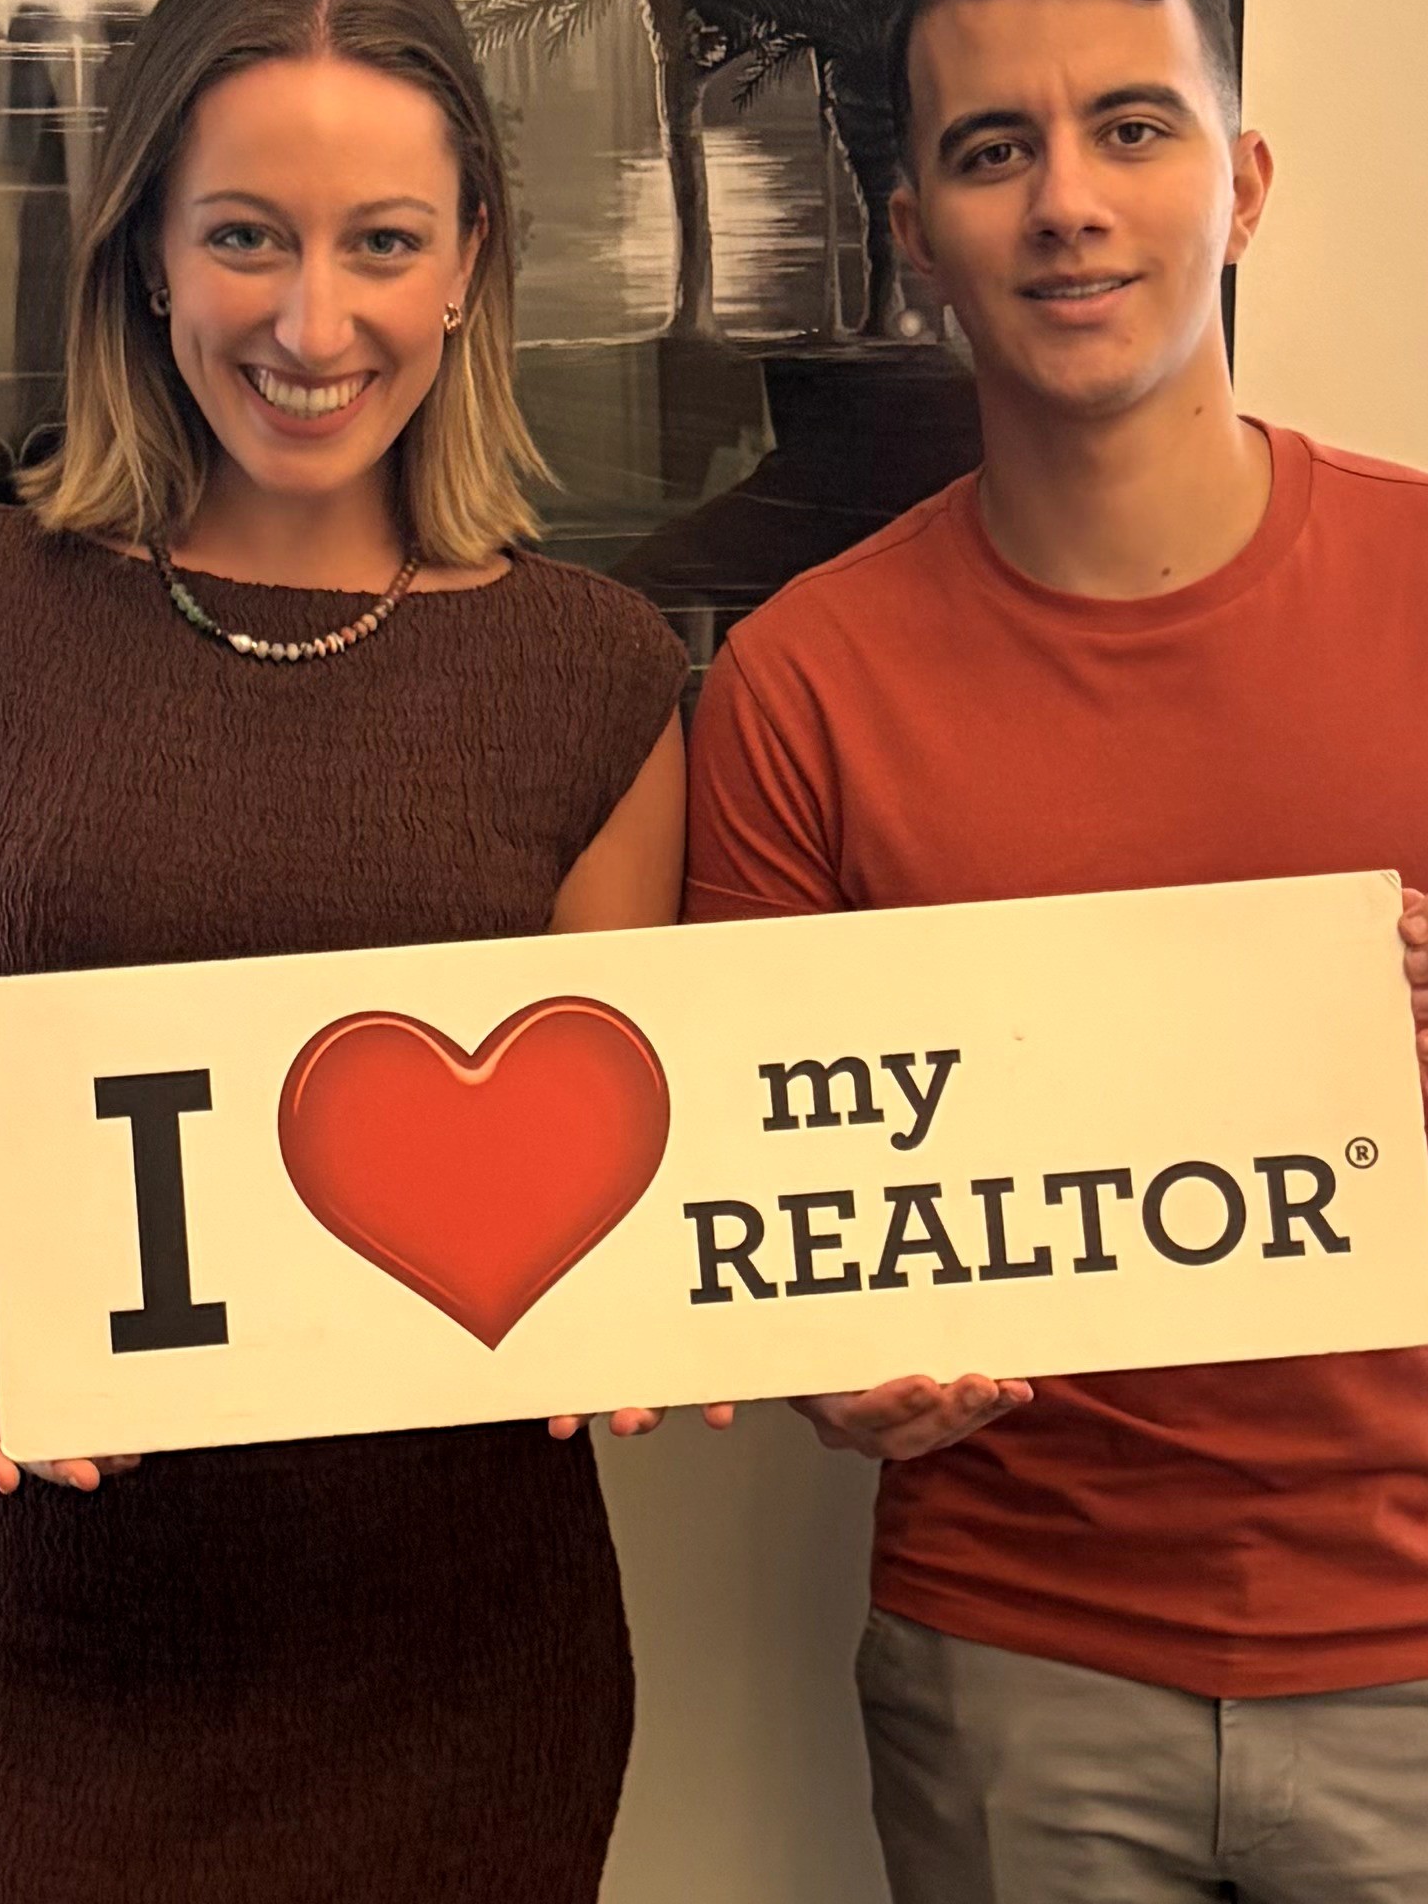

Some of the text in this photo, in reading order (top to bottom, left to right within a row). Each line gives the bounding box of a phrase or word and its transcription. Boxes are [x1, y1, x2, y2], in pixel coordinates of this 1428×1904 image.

[758, 1049, 961, 1151] my
[93, 1068, 229, 1354] I
[683, 1136, 1380, 1305] REALTOR®
